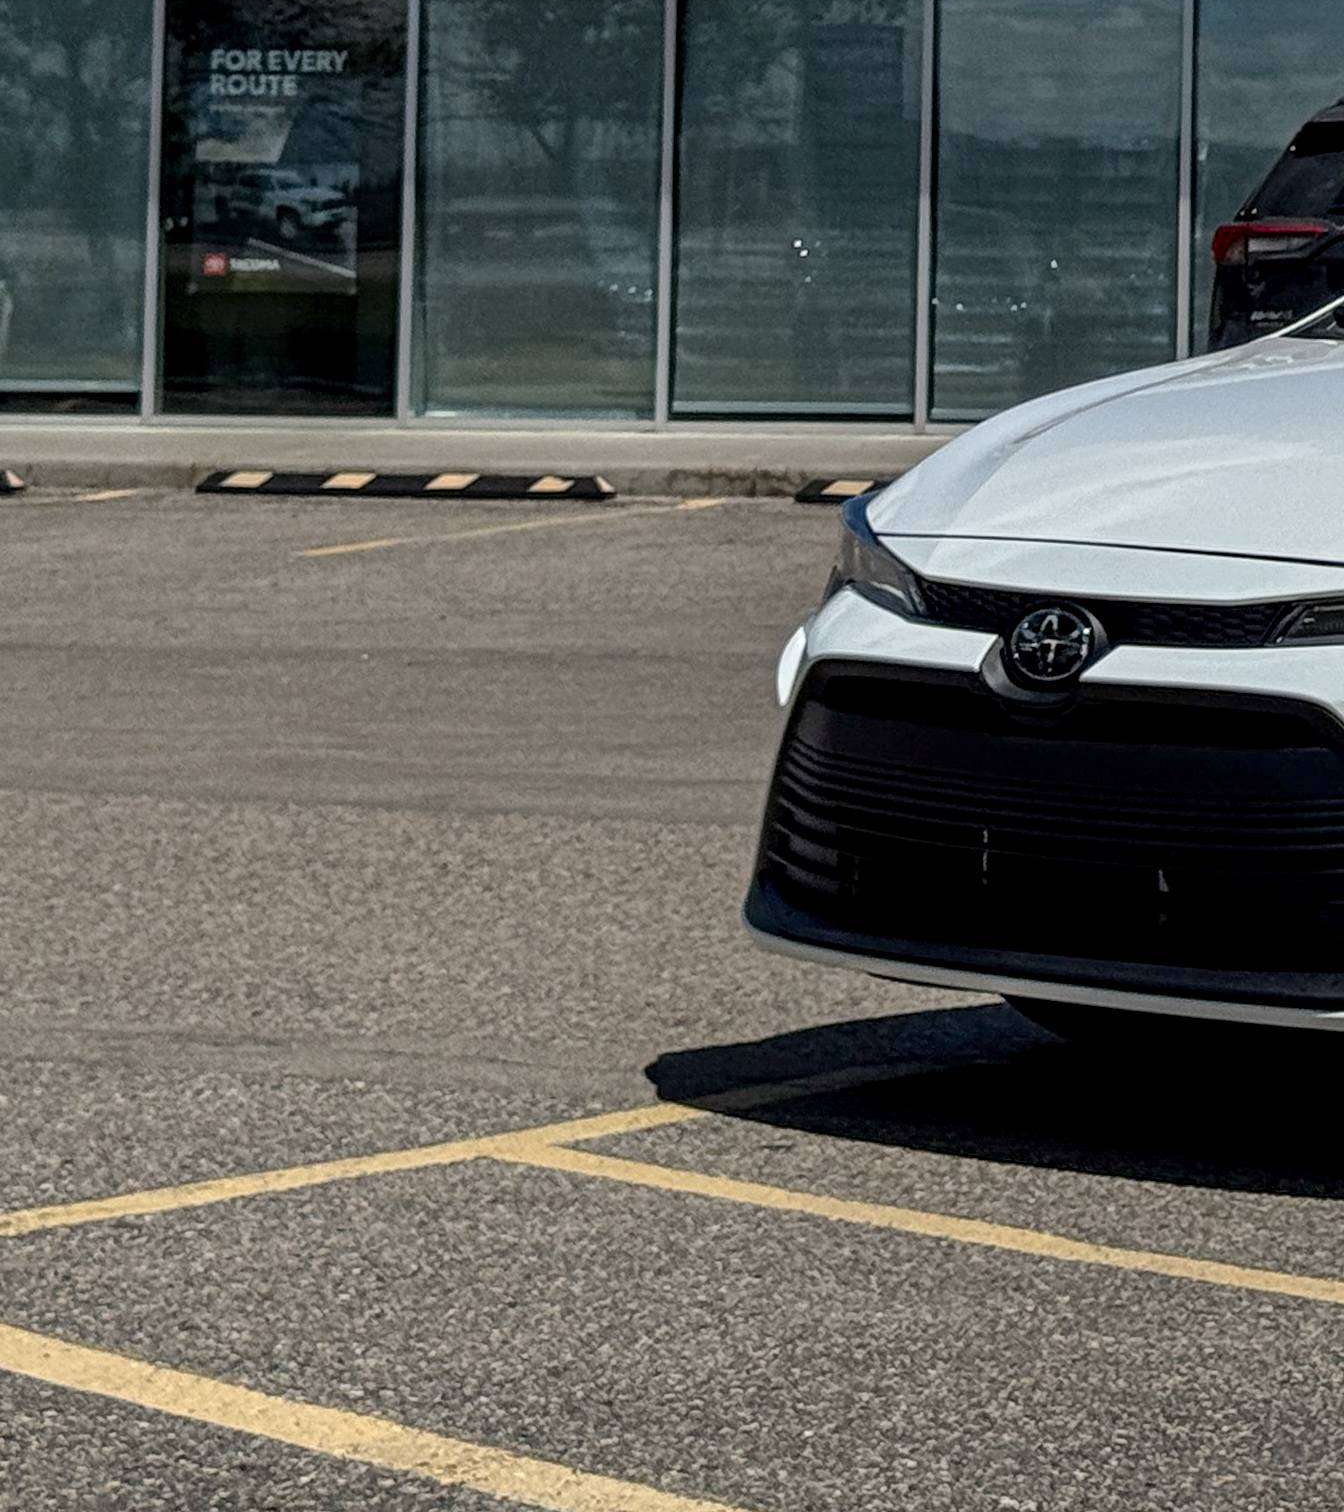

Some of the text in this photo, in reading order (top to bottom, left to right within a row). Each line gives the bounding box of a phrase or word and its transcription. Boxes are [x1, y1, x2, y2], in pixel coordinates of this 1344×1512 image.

[210, 49, 348, 72] FOR EVERY
[210, 73, 298, 96] ROUTE
